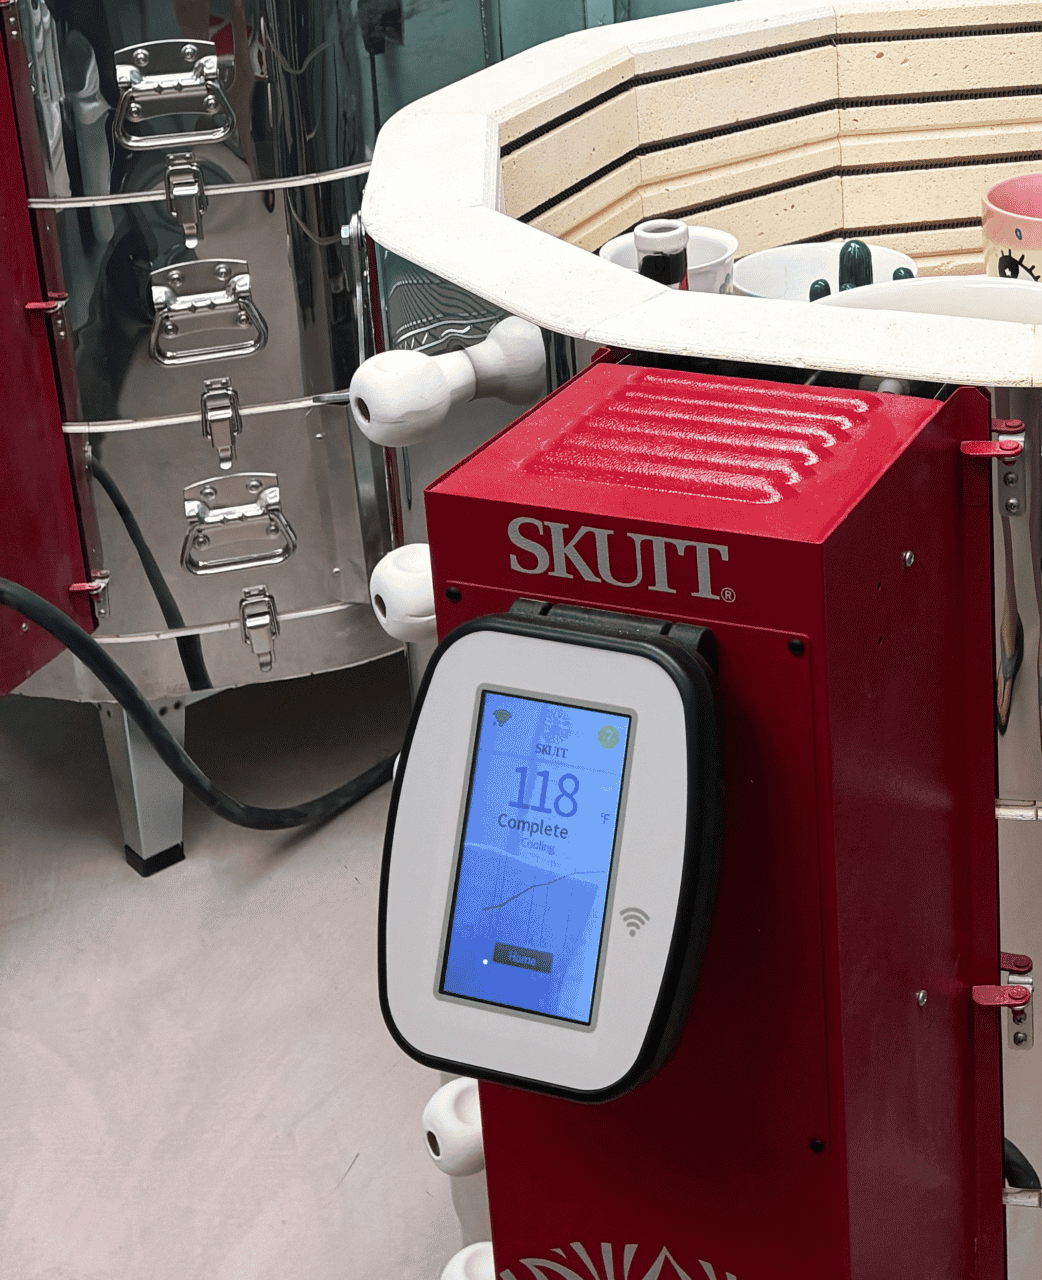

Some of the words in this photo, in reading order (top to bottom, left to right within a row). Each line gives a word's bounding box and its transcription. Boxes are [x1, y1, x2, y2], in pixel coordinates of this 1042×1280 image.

[535, 743, 569, 758] SKUTT
[508, 766, 580, 818] 118
[498, 813, 569, 839] Complete
[521, 837, 556, 856] Cooling
